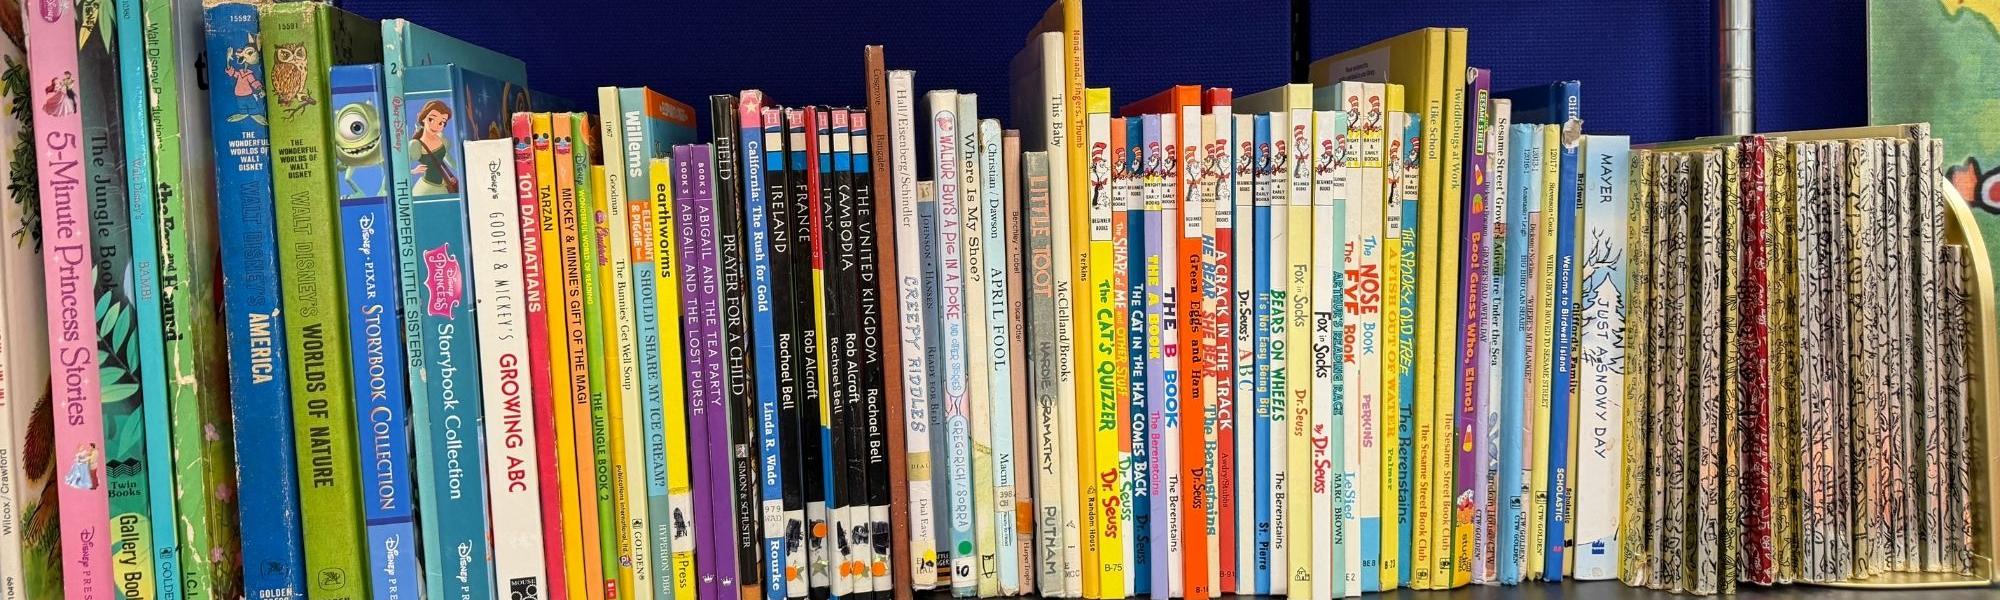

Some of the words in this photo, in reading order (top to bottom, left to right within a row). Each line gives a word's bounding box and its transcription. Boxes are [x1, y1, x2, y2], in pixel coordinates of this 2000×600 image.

[873, 69, 882, 105] Cosgrove
[1052, 94, 1063, 117] This
[1052, 122, 1064, 147] Baby
[1430, 106, 1439, 125] Like
[1451, 87, 1463, 149] Twiddlebugs
[91, 133, 108, 166] The
[279, 146, 318, 155] WONDERFUL
[625, 111, 643, 177] Willems
[876, 134, 886, 172] Bangalee
[1428, 128, 1438, 160] School
[1452, 152, 1460, 161] at
[1496, 118, 1507, 156] Sesame
[280, 154, 307, 163] WORLDS
[718, 136, 731, 180] FIELD
[748, 141, 761, 201] California:
[896, 90, 912, 228] Hall/Eisenberg/Schindler
[964, 132, 977, 183] Where
[988, 143, 998, 188] Christian
[1451, 163, 1460, 190] Work
[1549, 148, 1557, 173] 12017-1
[47, 132, 79, 239] 5-Minute
[609, 174, 619, 216] Goodman
[966, 189, 976, 201] Is
[1548, 182, 1556, 212] Stevenson
[1576, 173, 1584, 209] Bridwell
[1600, 153, 1613, 203] MAYER
[92, 174, 117, 238] Jungle
[396, 179, 414, 257] THUMPER'S
[540, 185, 554, 231] TARZAN
[752, 206, 763, 228] The
[771, 186, 786, 252] IRELAND
[796, 185, 810, 242] FRANCE
[823, 188, 834, 231] ITALY
[857, 185, 868, 216] THE
[966, 207, 978, 230] My
[989, 200, 1000, 239] Dawson
[1030, 176, 1050, 236] LITTLE
[359, 212, 376, 254] Disney
[656, 183, 672, 278] earthworms
[754, 233, 767, 261] Rush
[838, 185, 854, 270] CAMBODIA
[1011, 211, 1019, 244] Benchley
[99, 244, 118, 294] Book
[616, 259, 625, 279] The
[723, 234, 738, 291] PRAYER
[860, 223, 872, 281] UNITED
[968, 238, 980, 282] Shoe?
[1080, 253, 1088, 282] Perkins
[1471, 232, 1480, 268] Boo!
[1493, 242, 1503, 294] Adventure
[138, 260, 153, 301] BAMBI
[364, 262, 377, 299] PIXAR
[403, 262, 418, 305] LITTLE
[756, 265, 768, 282] for
[1033, 246, 1051, 298] TOOT
[1098, 279, 1112, 303] The
[1189, 254, 1200, 293] Green
[1360, 264, 1380, 314] NOSE
[1561, 255, 1571, 294] Welcome
[54, 244, 84, 341] Princess
[617, 281, 630, 323] Bunnies'
[640, 269, 654, 323] SHOULD
[757, 285, 770, 312] Gold
[991, 268, 1005, 319] APRIL
[1260, 293, 1269, 310] It's
[1469, 272, 1478, 319] Guess
[1492, 297, 1501, 326] Under
[1561, 297, 1569, 305] to
[728, 297, 741, 328] FOR
[862, 289, 876, 364] KINGDOM
[1057, 280, 1071, 382] McClelland/Brooks
[1097, 308, 1115, 355] CAT'S
[1190, 300, 1202, 333] Eggs
[1259, 314, 1268, 332] Not
[1314, 312, 1330, 333] Fox
[1560, 308, 1569, 343] Birdwell
[1596, 298, 1608, 340] JUST
[248, 313, 273, 384] AMERICA
[361, 304, 387, 402] STORYBOOK
[407, 310, 422, 368] SISTERS
[621, 325, 631, 342] Get
[730, 332, 743, 342] A
[993, 325, 1006, 371] FOOL
[1192, 340, 1202, 363] and
[1258, 336, 1268, 359] Easy
[1363, 322, 1376, 355] BOOK
[1464, 323, 1477, 364] Who,
[1492, 329, 1500, 346] the
[1596, 346, 1608, 357] A
[302, 324, 326, 392] WORLDS
[437, 324, 460, 410] Storybook
[622, 344, 633, 364] Well
[645, 334, 657, 381] SHARE
[731, 347, 746, 395] CHILD
[1314, 343, 1330, 378] Socks
[1491, 348, 1499, 366] Sea
[1559, 346, 1568, 372] Island
[60, 347, 91, 425] Stories
[622, 366, 634, 391] Soup
[648, 384, 659, 402] MY
[1098, 361, 1117, 432] QUIZZER
[1192, 369, 1202, 399] Ham
[1258, 364, 1268, 392] Being
[1464, 367, 1476, 413] Elmo!
[1594, 364, 1608, 420] SNOWY
[308, 399, 329, 418] OF
[499, 353, 524, 448] GROWING
[592, 392, 603, 411] THE
[650, 408, 661, 427] ICE
[868, 388, 880, 437] Rachael
[1258, 398, 1269, 418] Big!
[594, 415, 606, 454] JUNGLE
[1041, 394, 1054, 474] GRAMATKY
[1362, 394, 1373, 448] PERKINS
[310, 427, 334, 488] NATURE
[370, 406, 396, 510] COLLECTION
[444, 415, 462, 499] Collection
[652, 430, 665, 487] CREAM?
[870, 440, 882, 464] Bell
[1594, 427, 1606, 459] DAY
[508, 456, 526, 492] ABC
[597, 459, 608, 490] BOOK
[1100, 468, 1118, 492] Dr.
[1221, 453, 1229, 508] Awdry/Stubbs
[1275, 471, 1284, 490] The
[1334, 474, 1343, 502] MARC
[1088, 498, 1096, 526] Random
[1555, 468, 1564, 522] SCHOLASTIC
[2, 502, 12, 535] Wilcox
[1103, 499, 1120, 538] Seuss
[1275, 493, 1285, 549] Berenstains
[1335, 508, 1344, 544] BROWN
[119, 515, 141, 565] Gallery
[658, 524, 670, 571] HYPERION
[1044, 506, 1057, 574] PUTNAM
[677, 560, 689, 588] Press
[771, 540, 782, 591] Rourke
[1104, 564, 1123, 572] B-75
